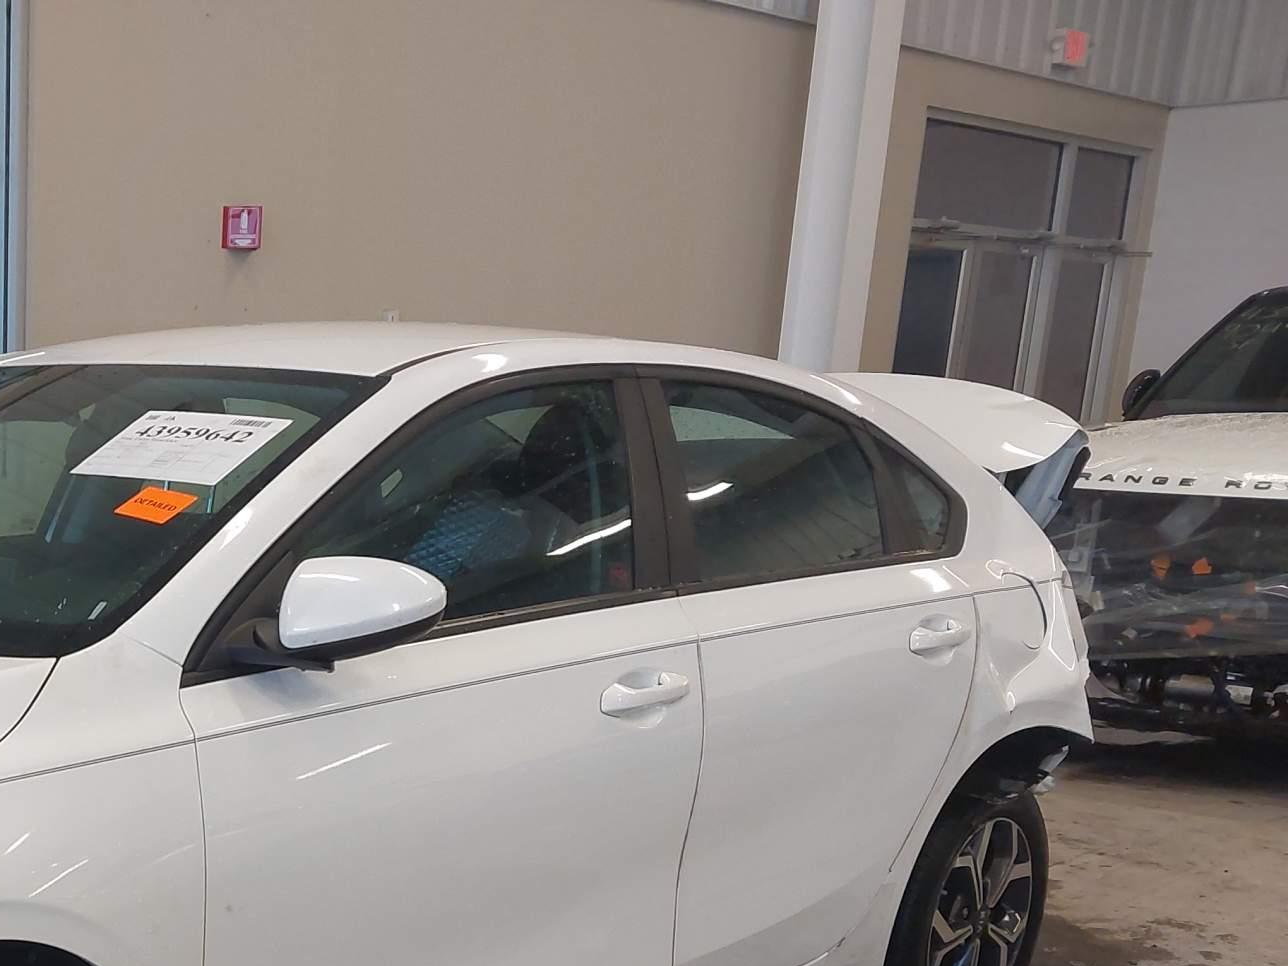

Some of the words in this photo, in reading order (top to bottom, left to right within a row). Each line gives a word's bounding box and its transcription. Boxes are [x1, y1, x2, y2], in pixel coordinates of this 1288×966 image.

[135, 424, 254, 443] 43959642
[1079, 472, 1198, 487] RANGE
[1224, 479, 1288, 490] RO
